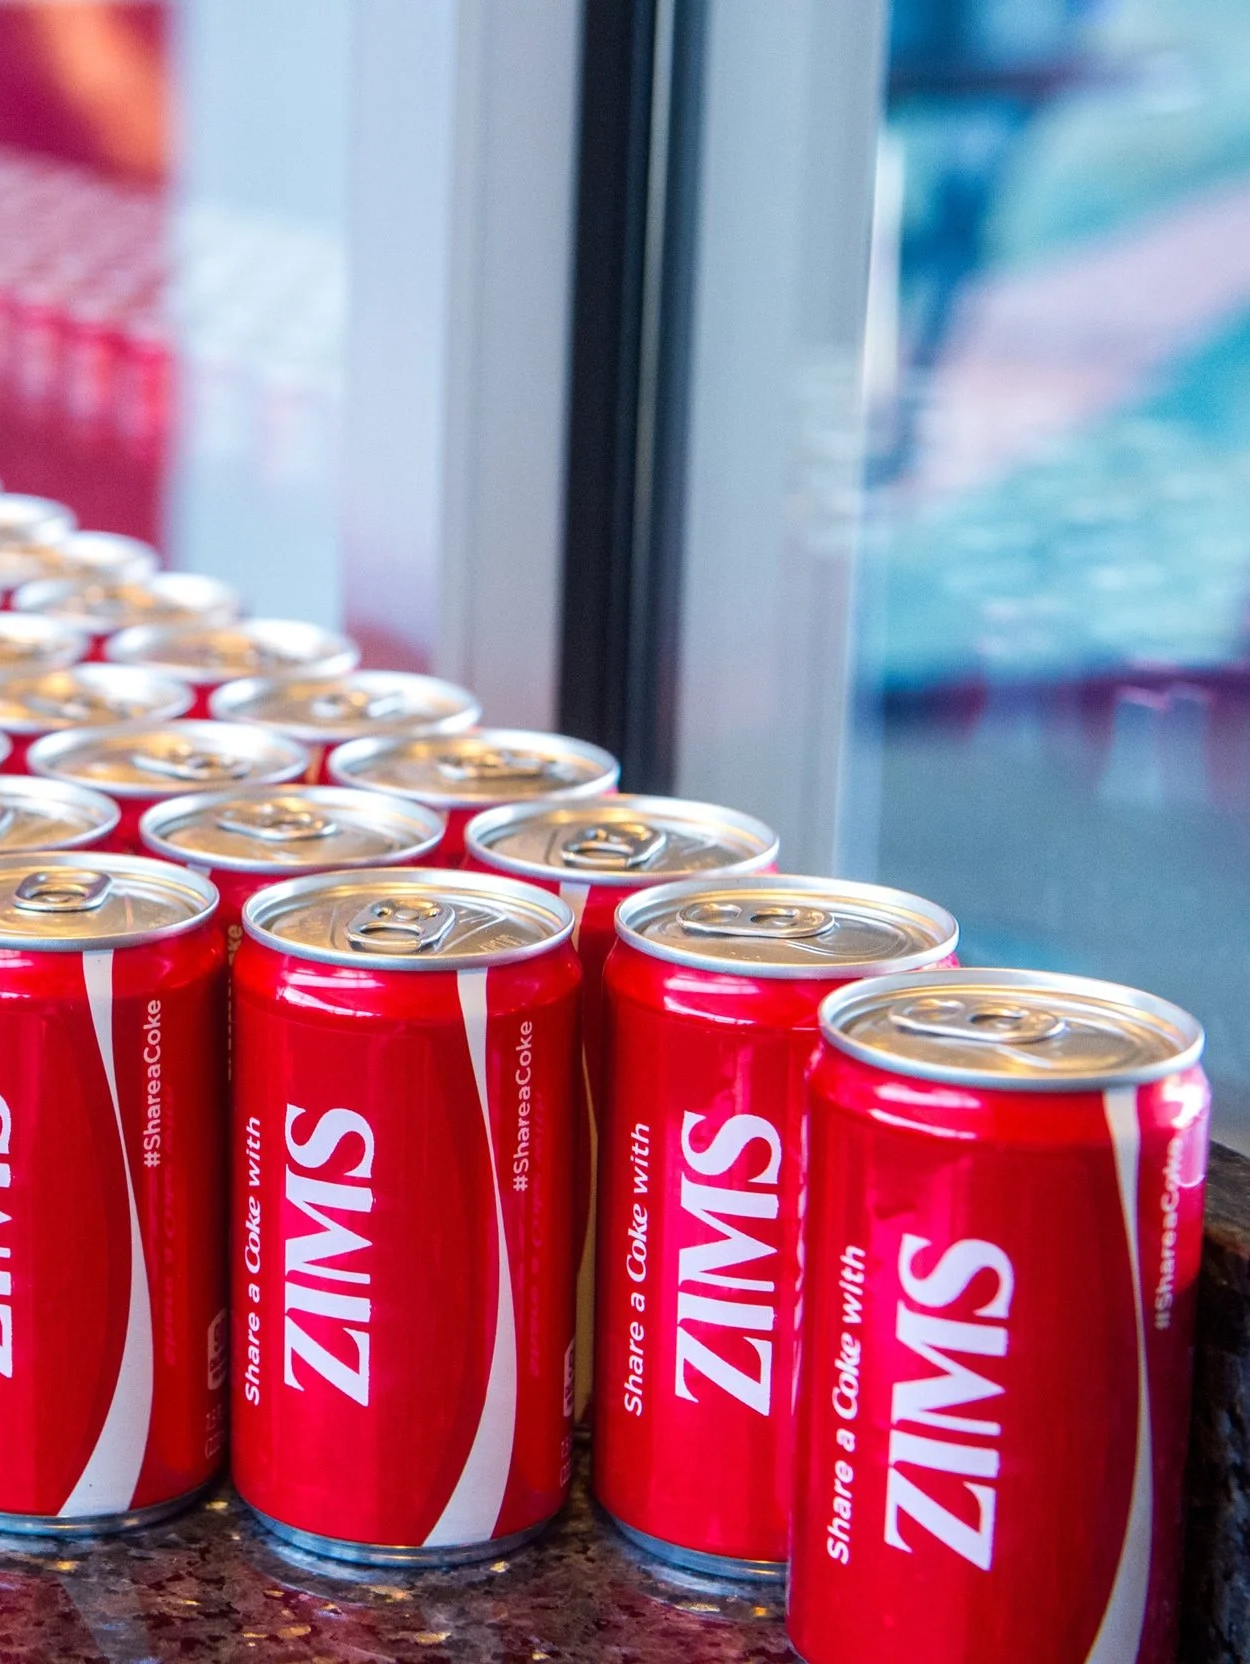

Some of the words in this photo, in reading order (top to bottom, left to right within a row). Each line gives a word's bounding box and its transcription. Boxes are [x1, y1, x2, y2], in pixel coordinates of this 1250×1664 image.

[143, 999, 162, 1168] #ShareaCoke
[512, 1020, 533, 1192] #ShareaCoke
[246, 1117, 261, 1186] with
[630, 1123, 650, 1194] with
[245, 1196, 261, 1274] Coke
[283, 1103, 376, 1407] ZIMS
[626, 1203, 648, 1283] Coke
[674, 1110, 782, 1417] ZIMS
[248, 1284, 261, 1303] a
[630, 1292, 645, 1313] a
[839, 1245, 866, 1324] with
[244, 1313, 261, 1406] Share
[623, 1322, 645, 1417] Share
[831, 1332, 862, 1420] Coke
[883, 1233, 1014, 1571] ZIMS
[836, 1429, 856, 1452] a
[826, 1461, 854, 1565] Share
